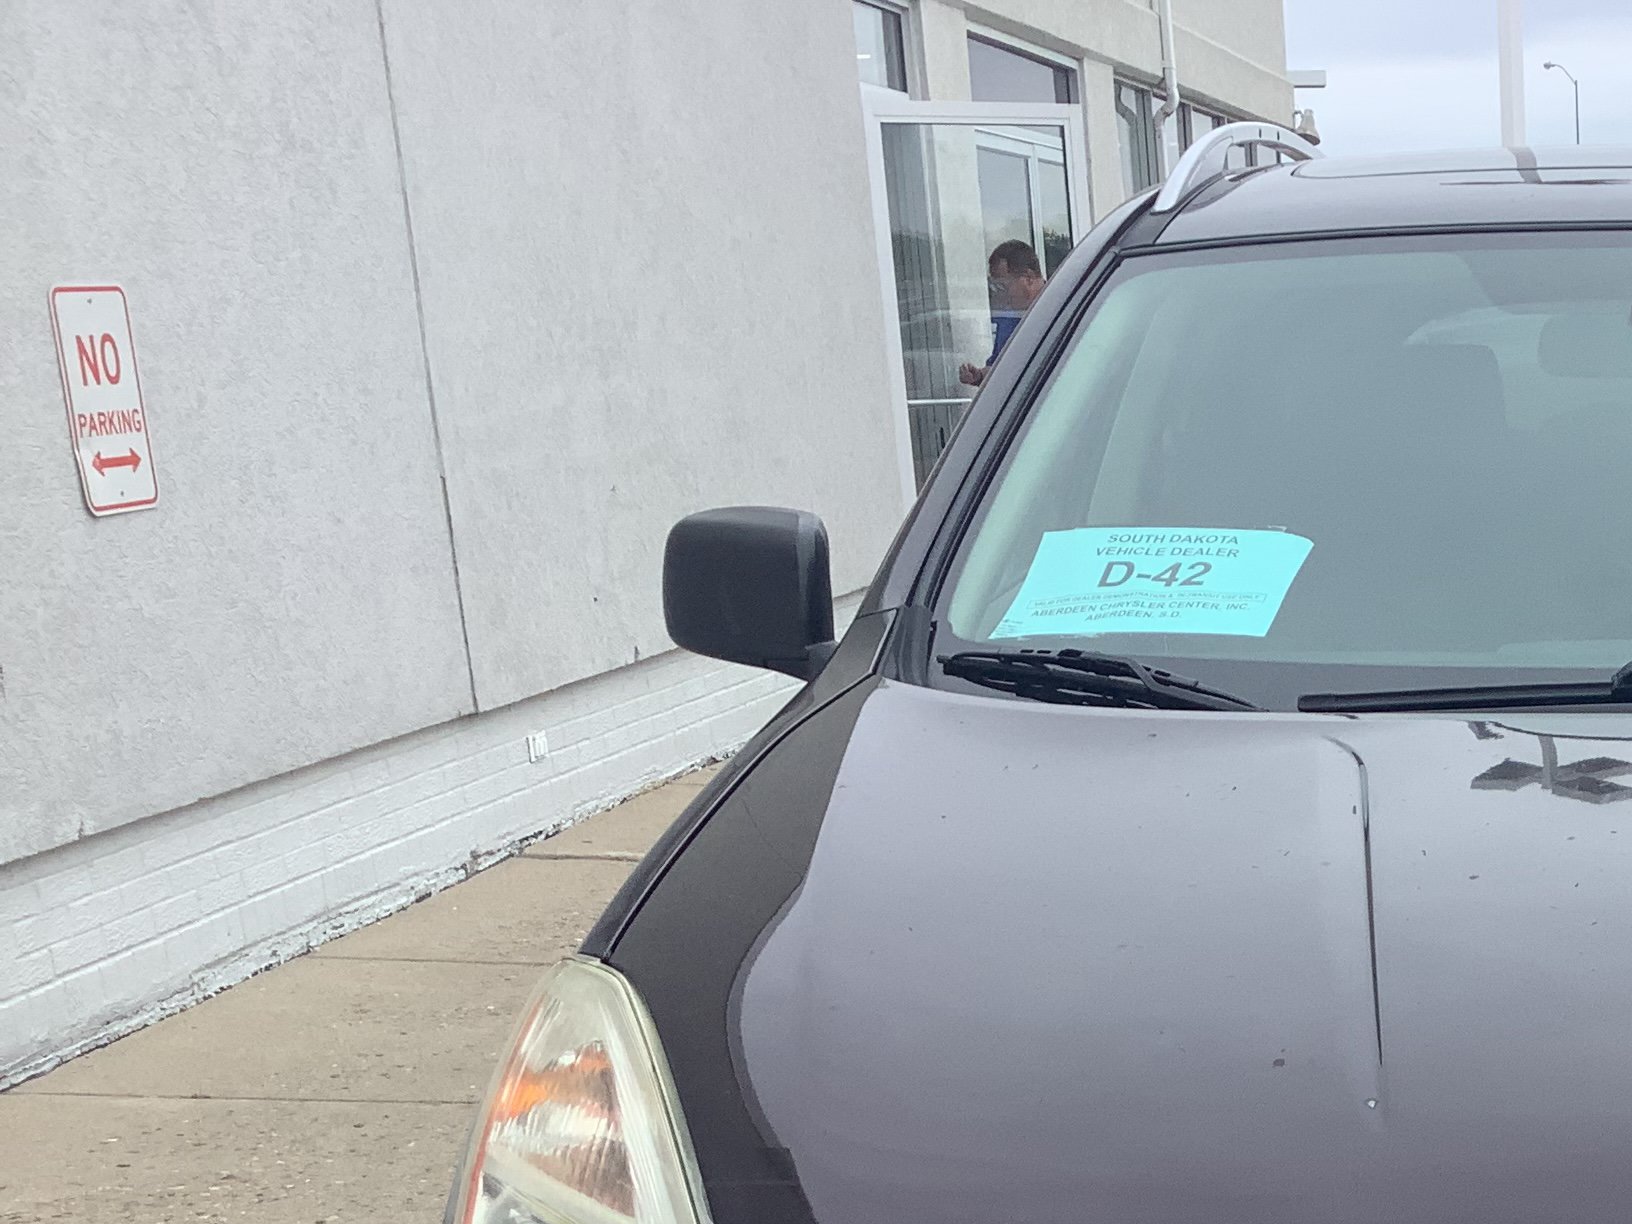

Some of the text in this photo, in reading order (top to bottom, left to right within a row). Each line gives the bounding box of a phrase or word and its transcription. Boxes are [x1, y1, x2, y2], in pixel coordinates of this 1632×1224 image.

[75, 332, 121, 387] NO
[77, 408, 143, 439] PARKING
[1107, 533, 1239, 545] SOUTH DAKOTA
[1096, 547, 1240, 558] VEHICLE DEALER
[1096, 560, 1213, 588] D-42
[1031, 604, 1097, 617] ABERDEEN
[1099, 599, 1166, 611] CHRYSLER
